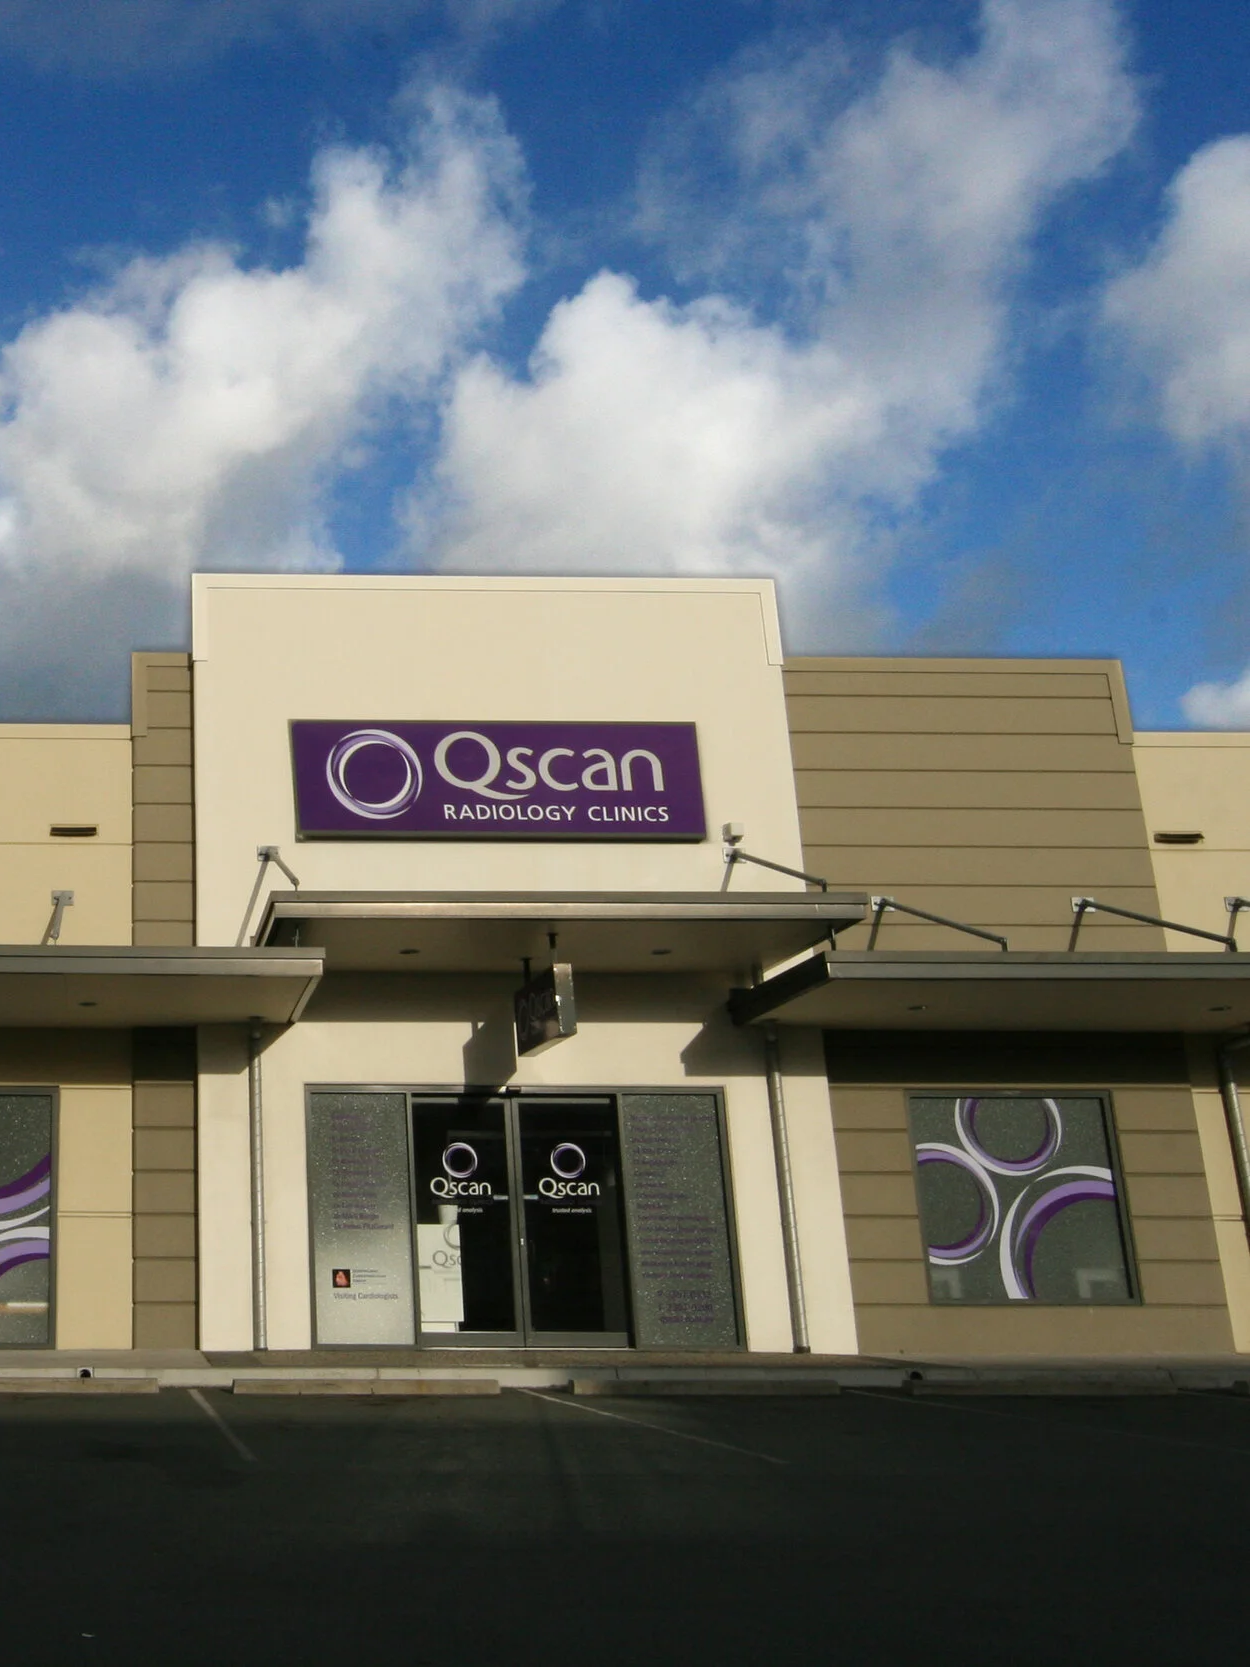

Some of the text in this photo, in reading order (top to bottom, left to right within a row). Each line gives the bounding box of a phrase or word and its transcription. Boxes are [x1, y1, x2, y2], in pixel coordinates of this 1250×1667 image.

[434, 731, 665, 800] Qscan
[444, 804, 669, 822] RADIOLOGY CLINICS
[430, 1177, 491, 1199] Qscan
[539, 1177, 600, 1199] Qscan
